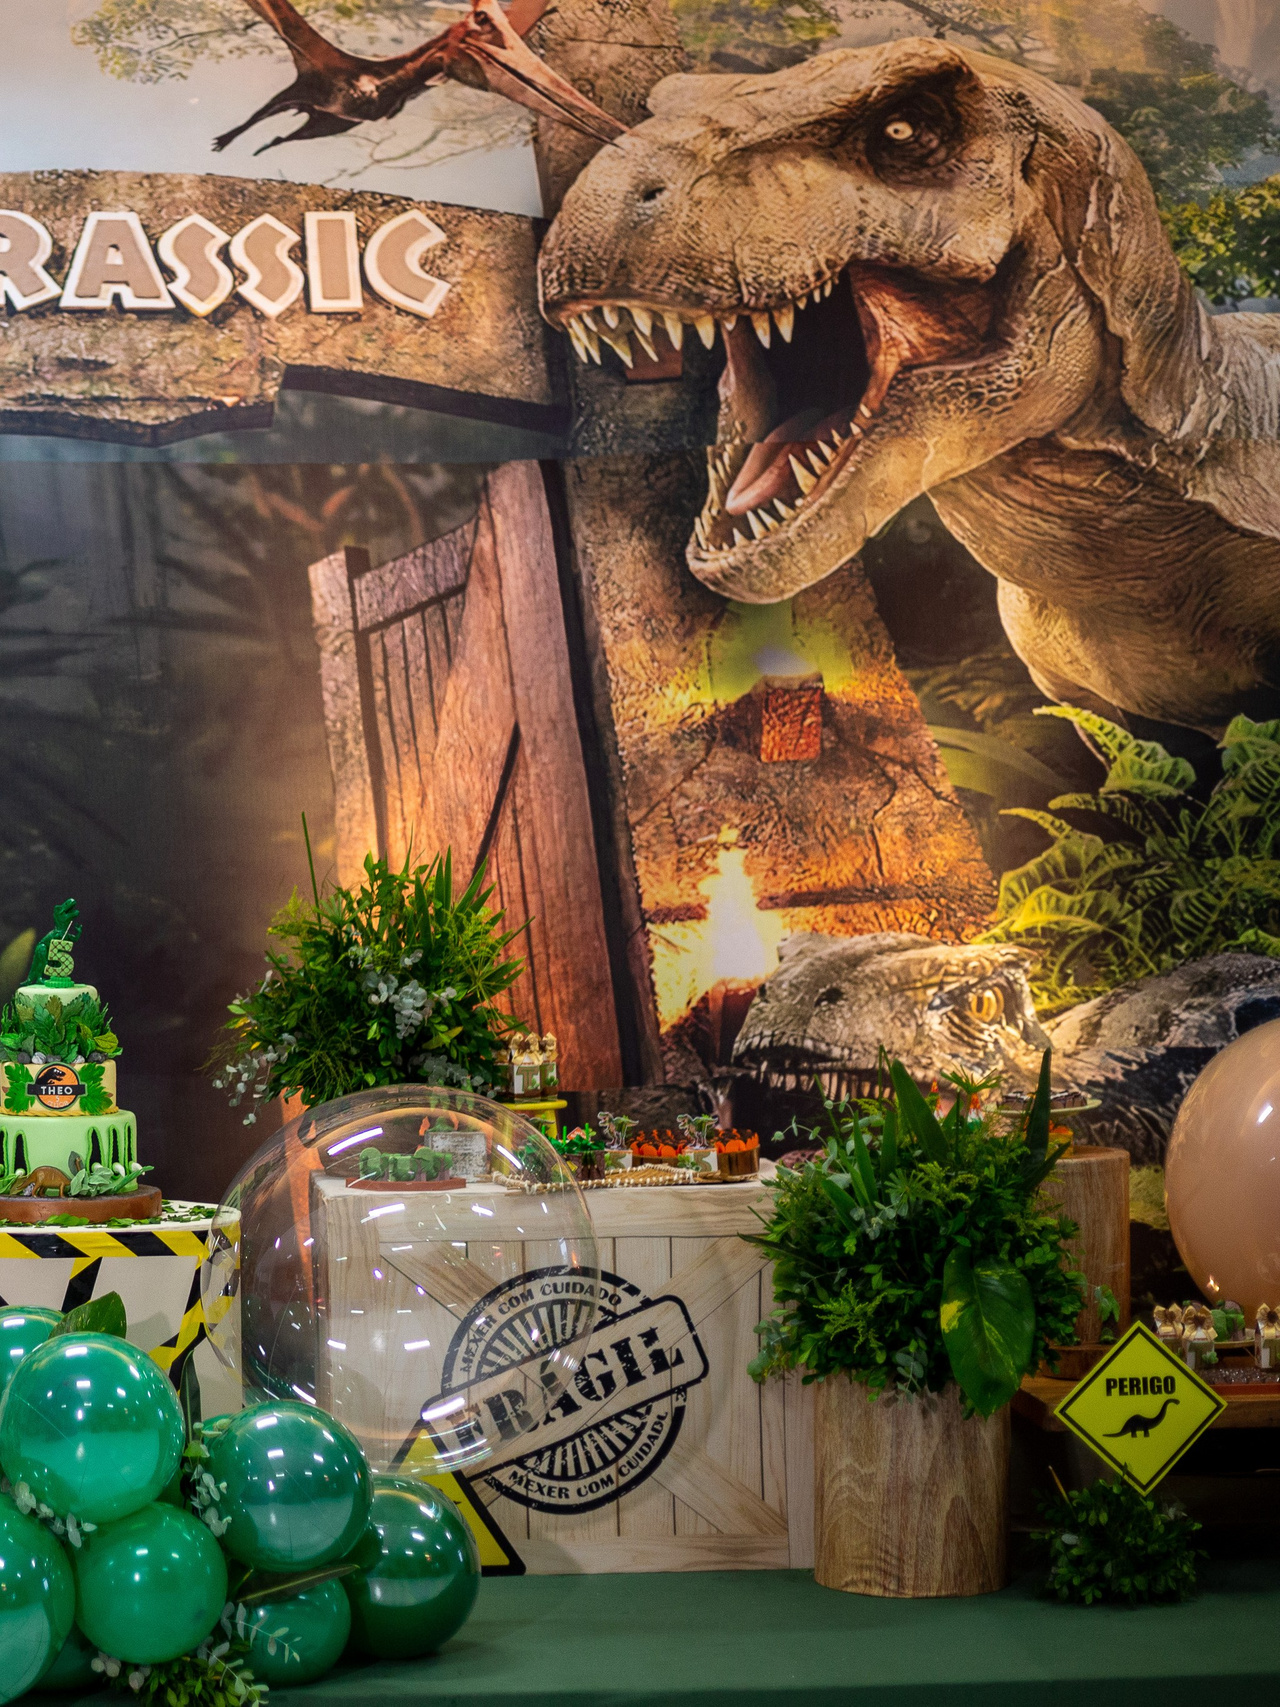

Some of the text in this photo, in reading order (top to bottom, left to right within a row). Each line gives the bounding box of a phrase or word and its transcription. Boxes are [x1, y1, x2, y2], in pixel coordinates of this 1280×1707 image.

[44, 939, 74, 977] 5
[40, 1085, 73, 1095] THEO
[459, 1281, 622, 1373] MEXER COM CUIDADO
[1105, 1376, 1176, 1397] PERIGO
[508, 1470, 570, 1499] MEXER
[576, 1474, 615, 1497] COM
